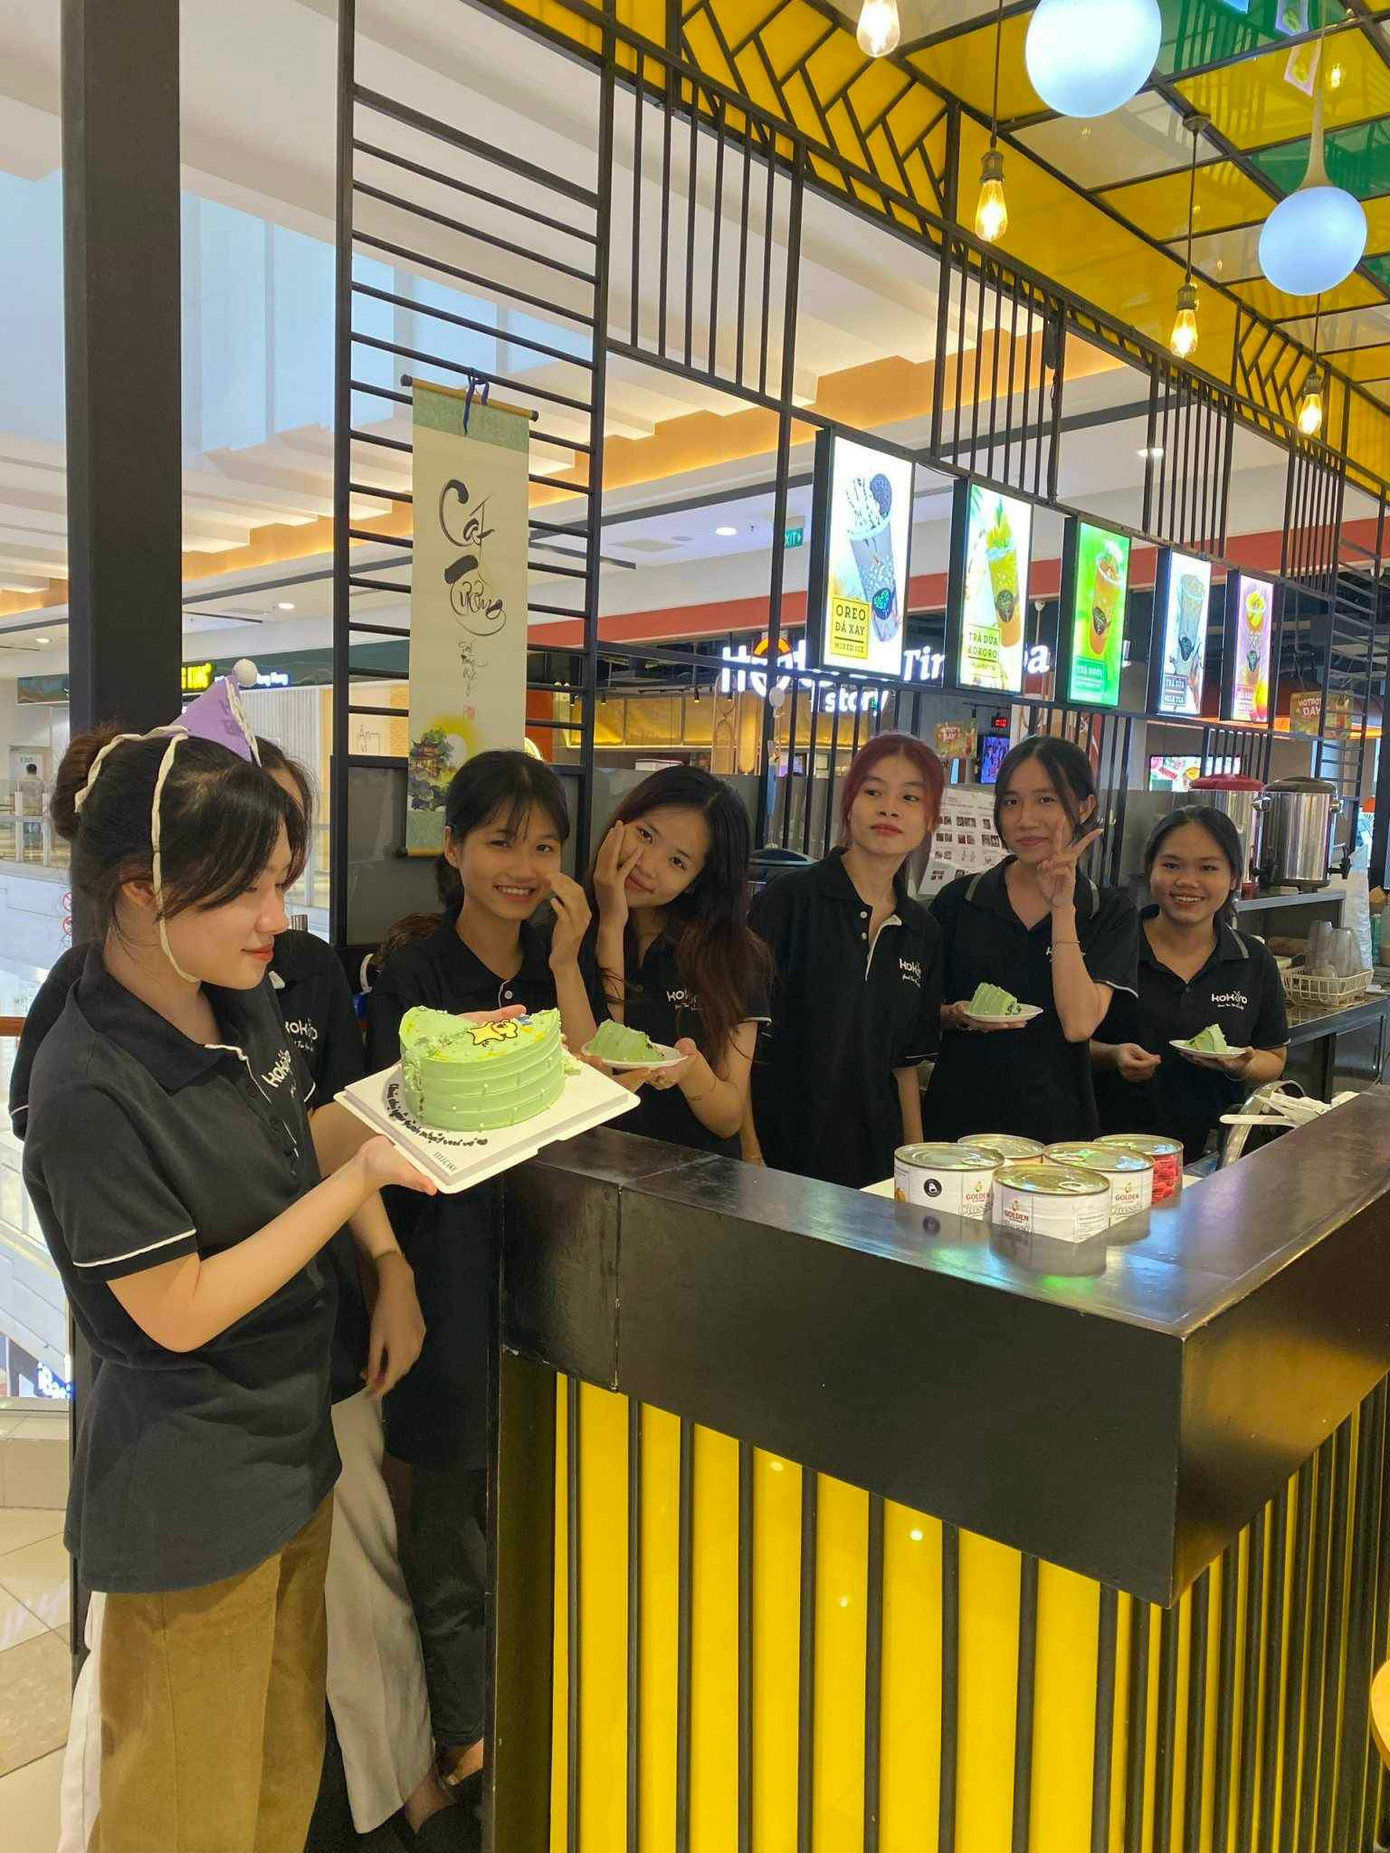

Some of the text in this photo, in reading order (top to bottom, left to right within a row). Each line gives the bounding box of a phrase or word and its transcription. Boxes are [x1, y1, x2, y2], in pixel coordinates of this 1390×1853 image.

[836, 604, 866, 621] OREO
[835, 620, 865, 636] ĐÁ XAY
[1114, 1193, 1139, 1201] GOLDEN
[1004, 1209, 1030, 1221] GOLDEN
